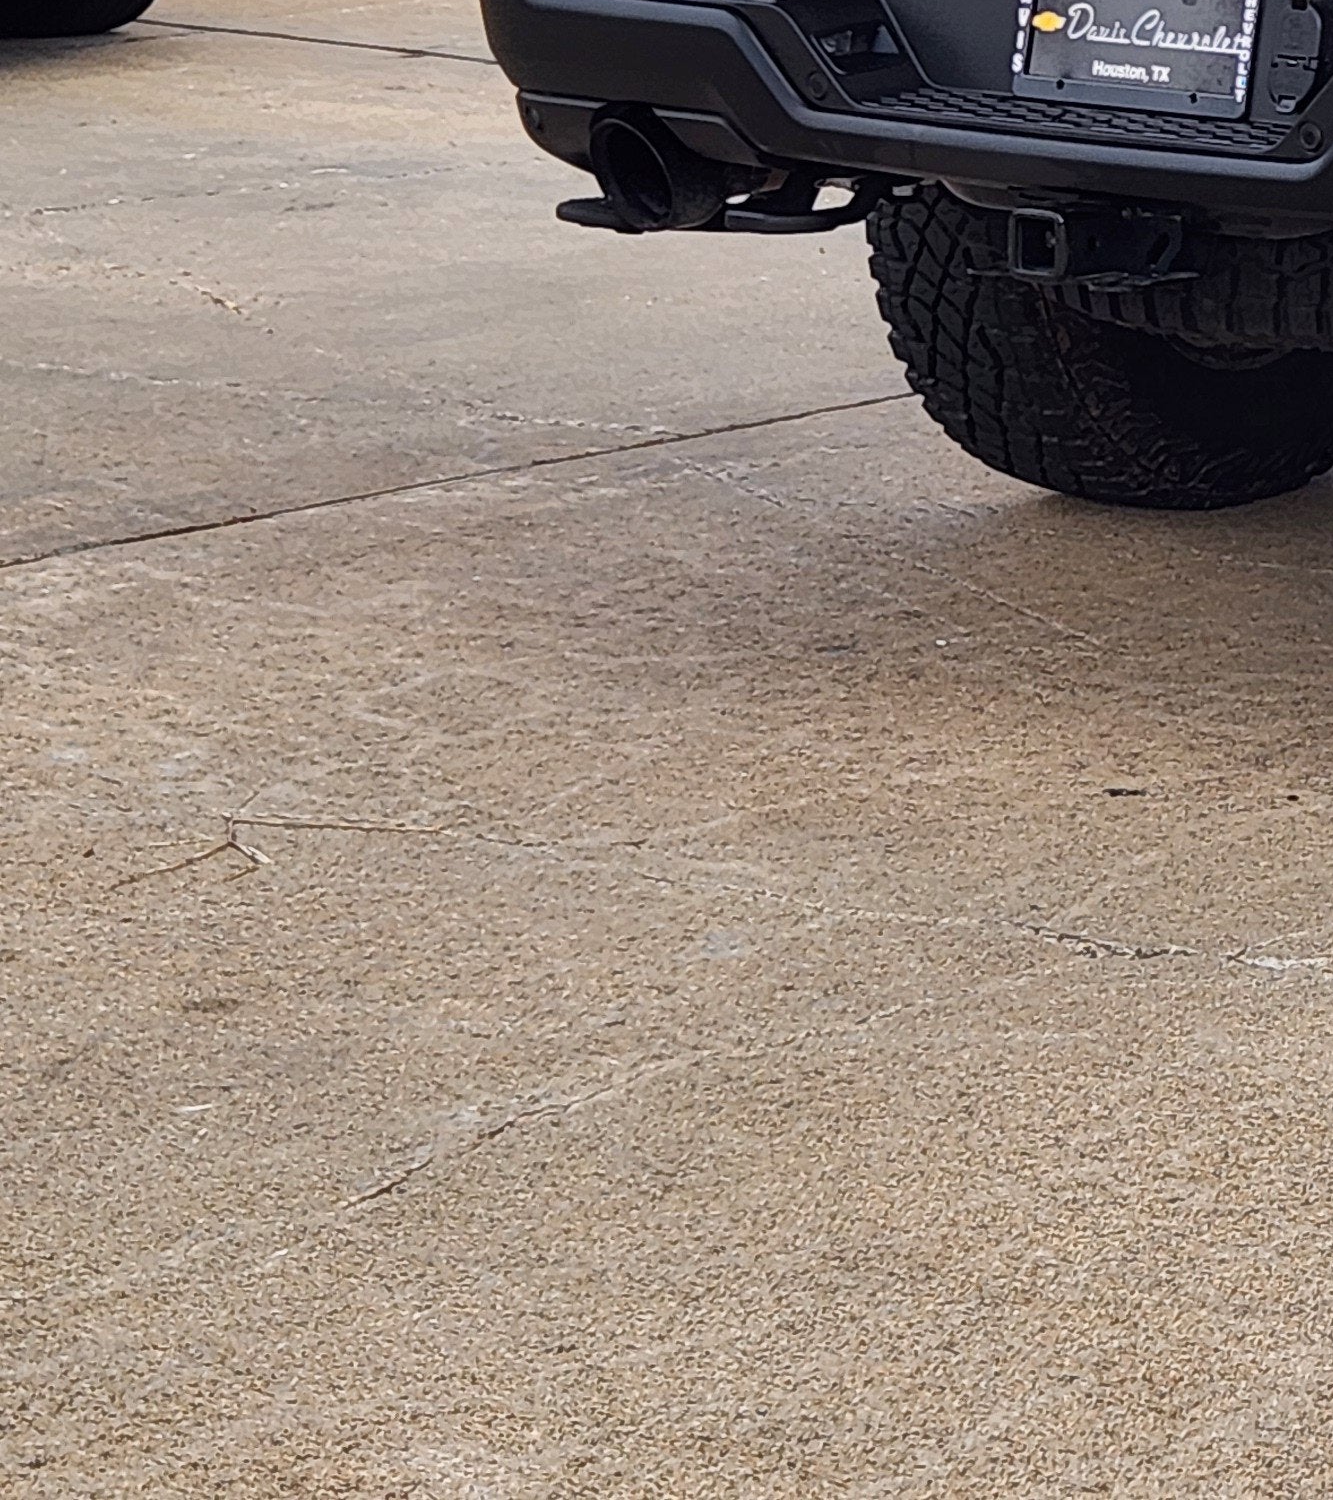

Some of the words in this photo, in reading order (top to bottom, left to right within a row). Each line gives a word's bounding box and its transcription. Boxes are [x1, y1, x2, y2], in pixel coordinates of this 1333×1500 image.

[1067, 3, 1131, 44] Davis
[1131, 9, 1245, 55] Chevrolet
[1092, 59, 1149, 84] Houston,
[1151, 64, 1171, 82] TX
